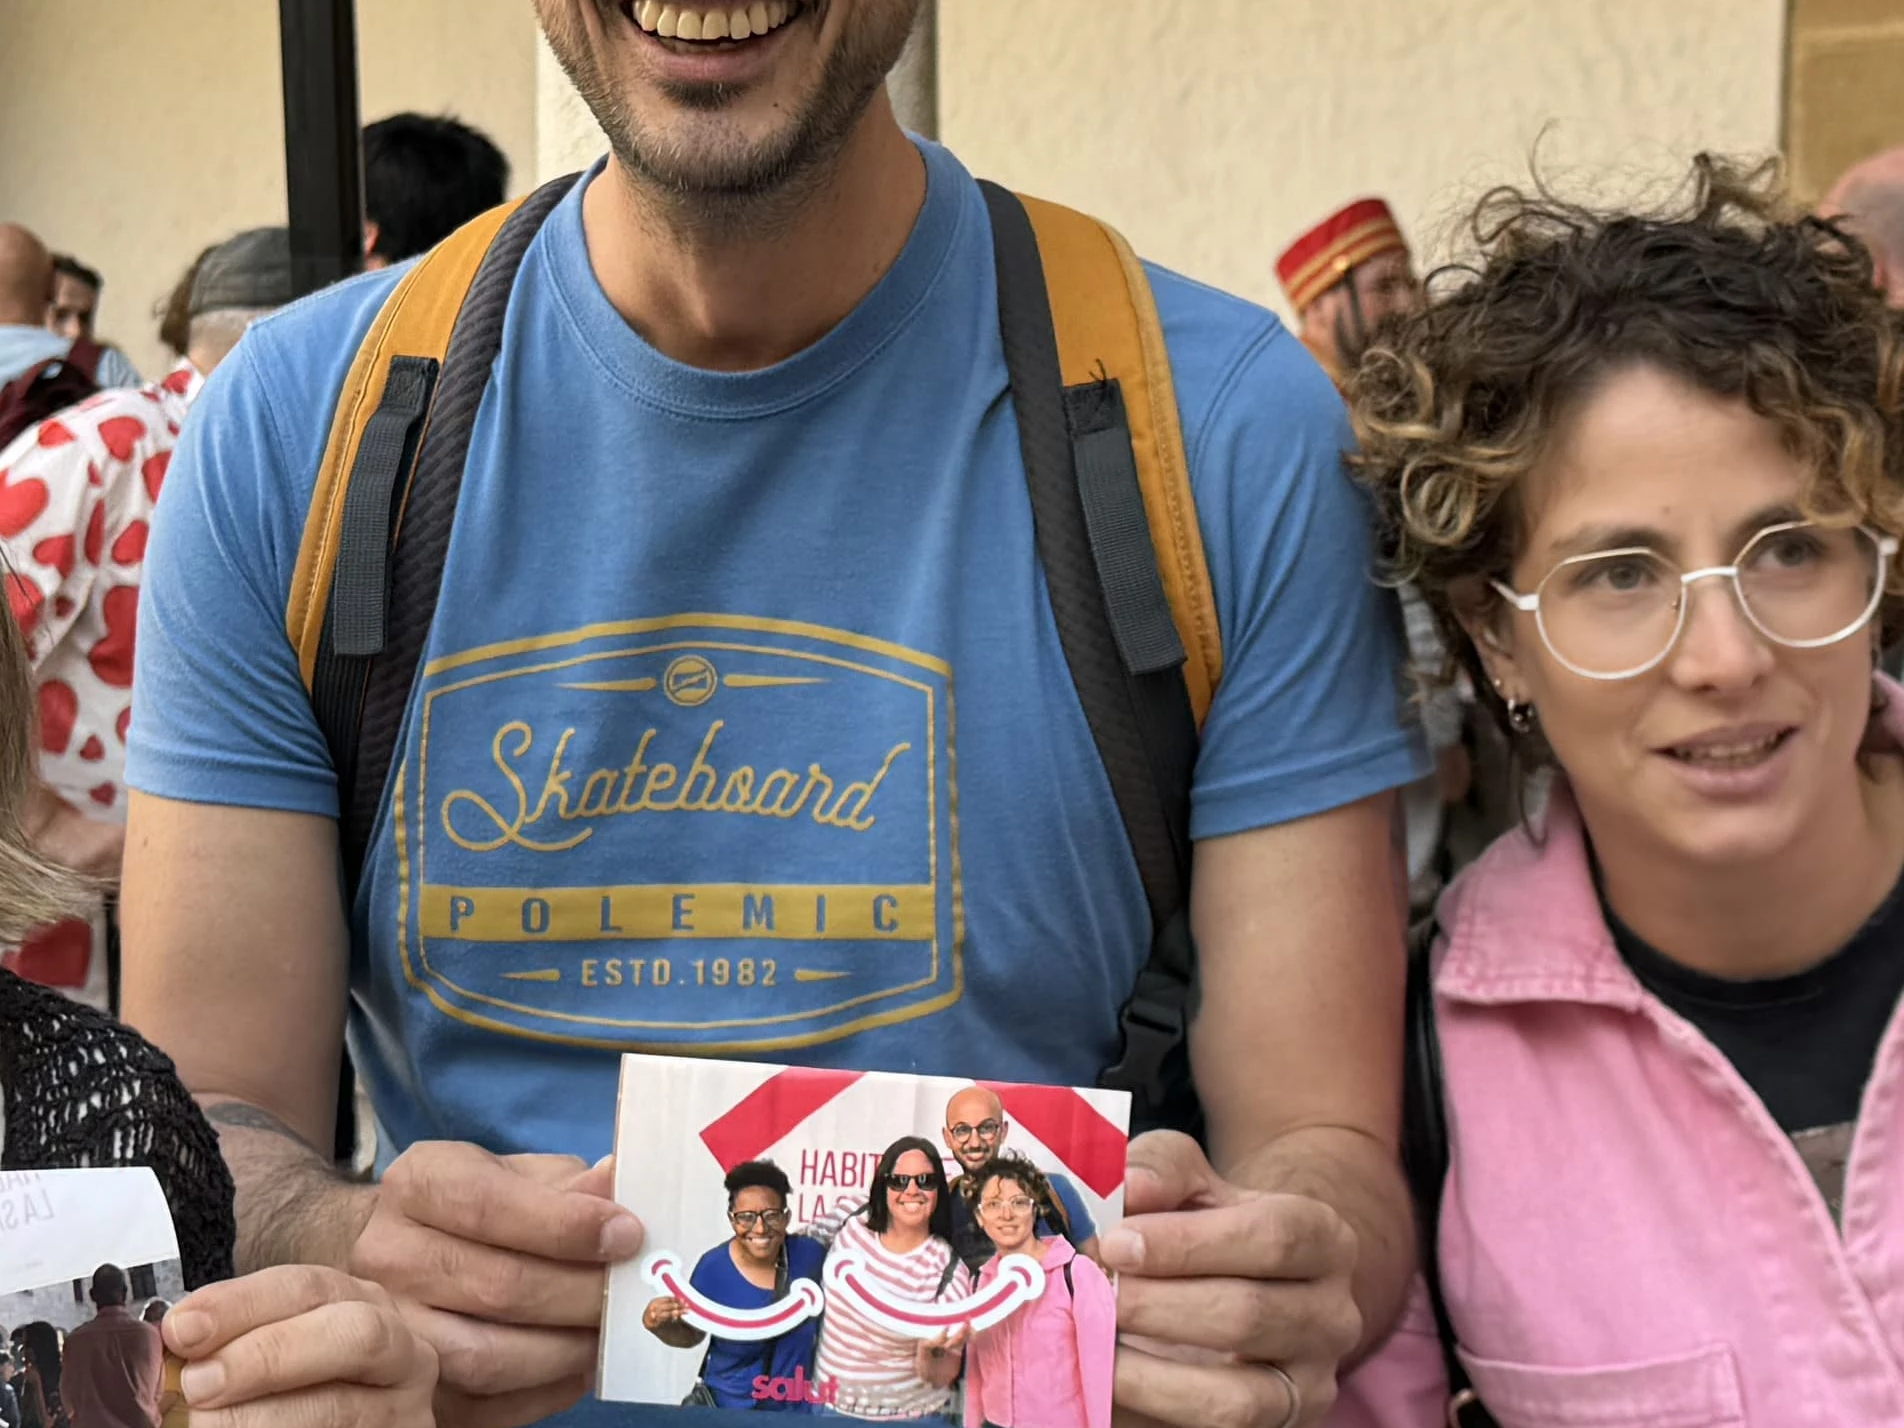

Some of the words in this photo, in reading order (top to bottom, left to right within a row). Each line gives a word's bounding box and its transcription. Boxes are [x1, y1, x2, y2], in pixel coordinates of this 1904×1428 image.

[441, 720, 911, 852] Skateboard
[449, 893, 899, 934] POLEMIC
[581, 957, 778, 988] ESTD.1982
[800, 1148, 884, 1189] HABIT
